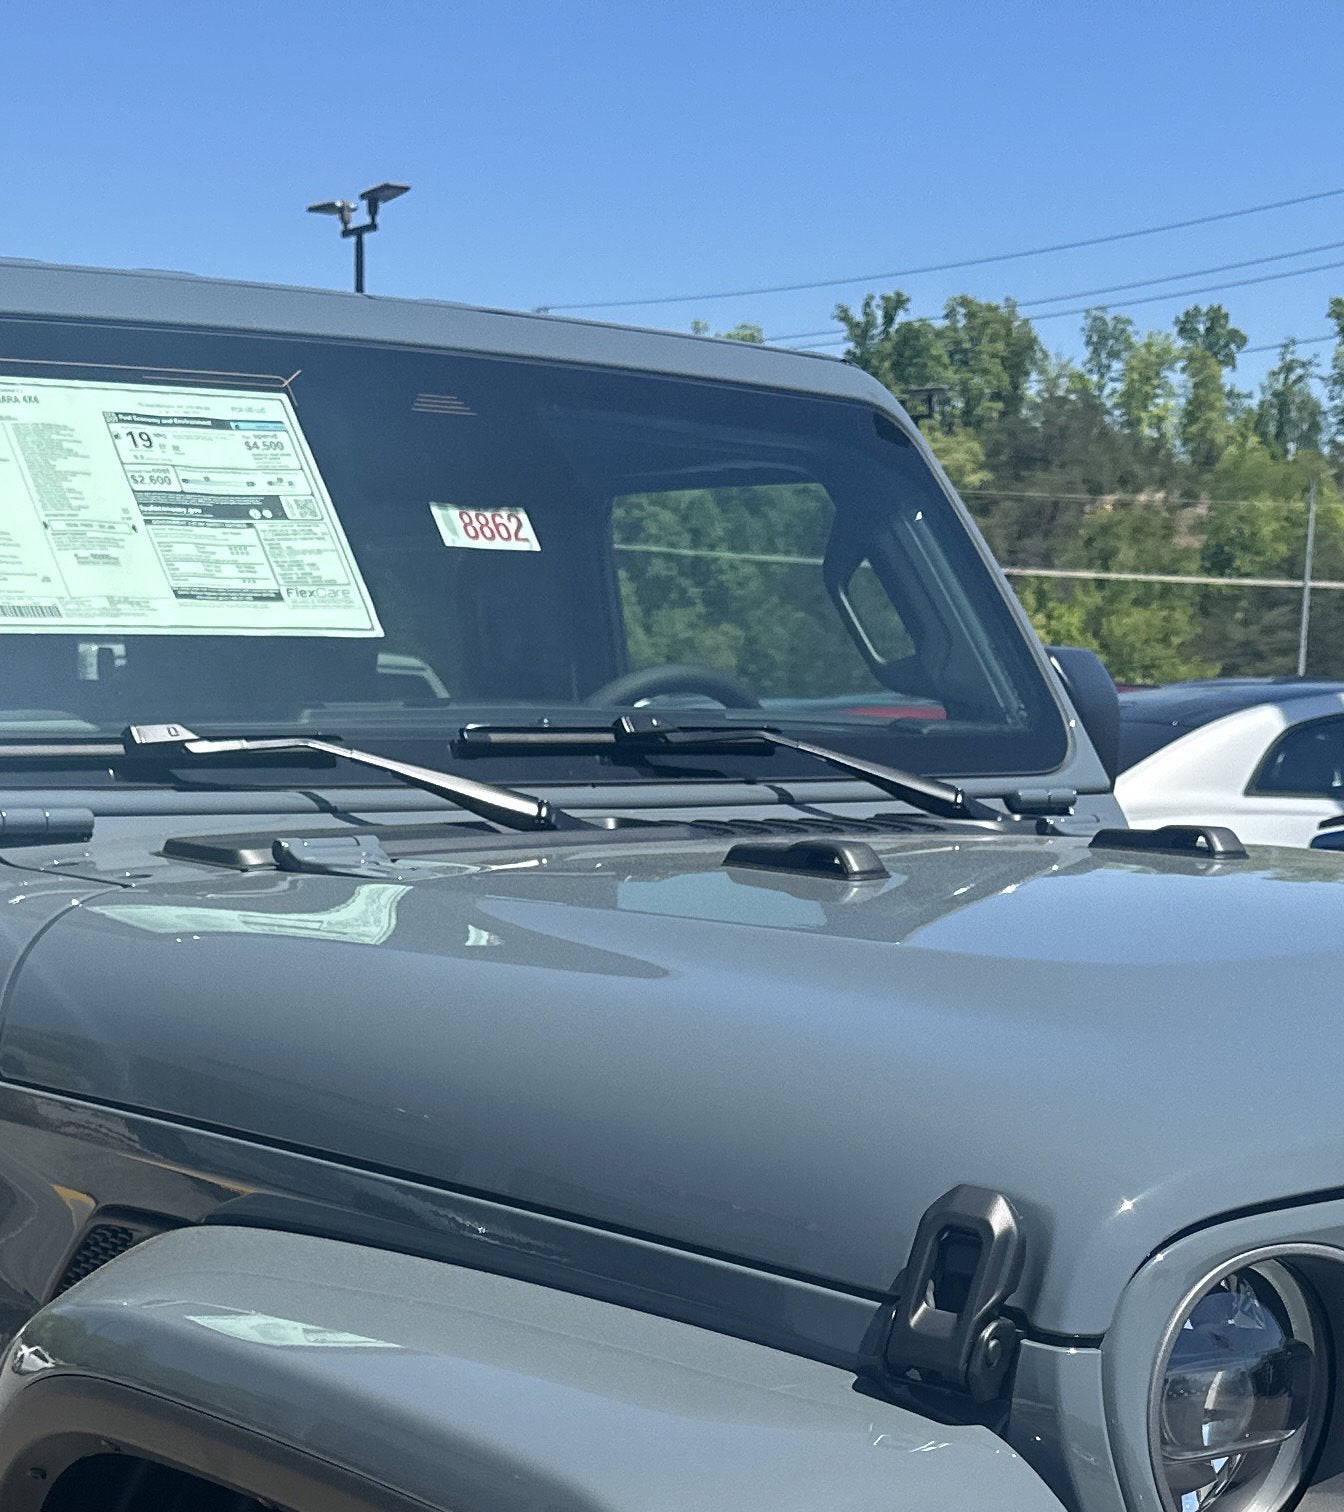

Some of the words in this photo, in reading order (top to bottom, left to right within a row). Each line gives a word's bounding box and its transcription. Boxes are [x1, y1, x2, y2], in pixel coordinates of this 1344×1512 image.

[126, 430, 154, 449] 19
[458, 510, 531, 542] 8862
[286, 587, 351, 598] FlexCare
